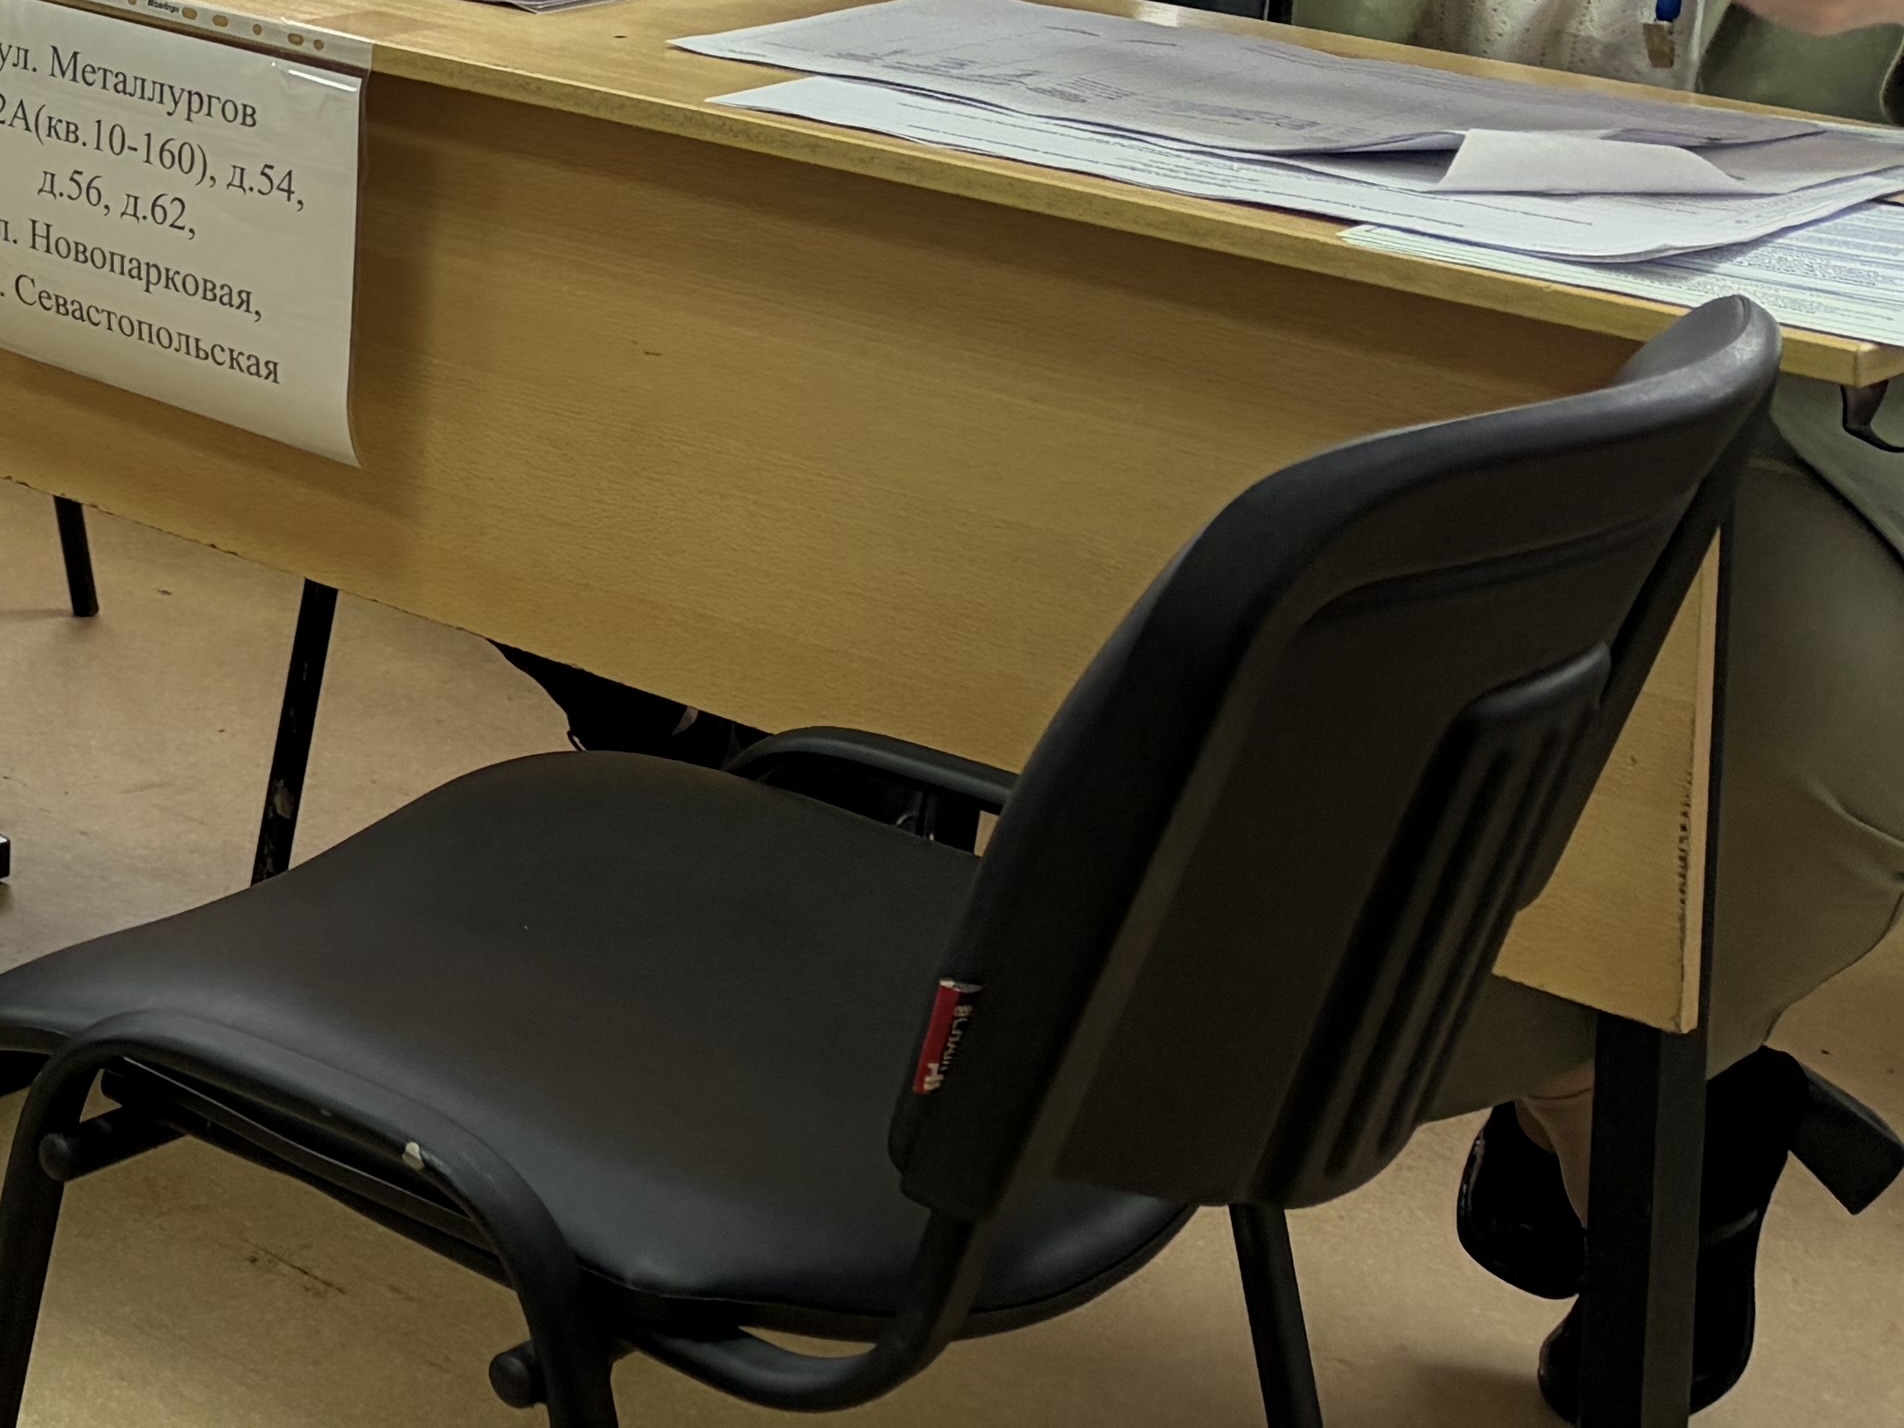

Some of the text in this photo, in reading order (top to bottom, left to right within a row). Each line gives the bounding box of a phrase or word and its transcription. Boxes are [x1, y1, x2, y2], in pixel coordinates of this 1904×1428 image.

[48, 44, 258, 129] Металлургов
[36, 169, 198, 241] д.56, д.62,
[225, 162, 306, 213] д.54,
[28, 217, 262, 324] Новопарковая,
[14, 272, 281, 385] Севастопольская
